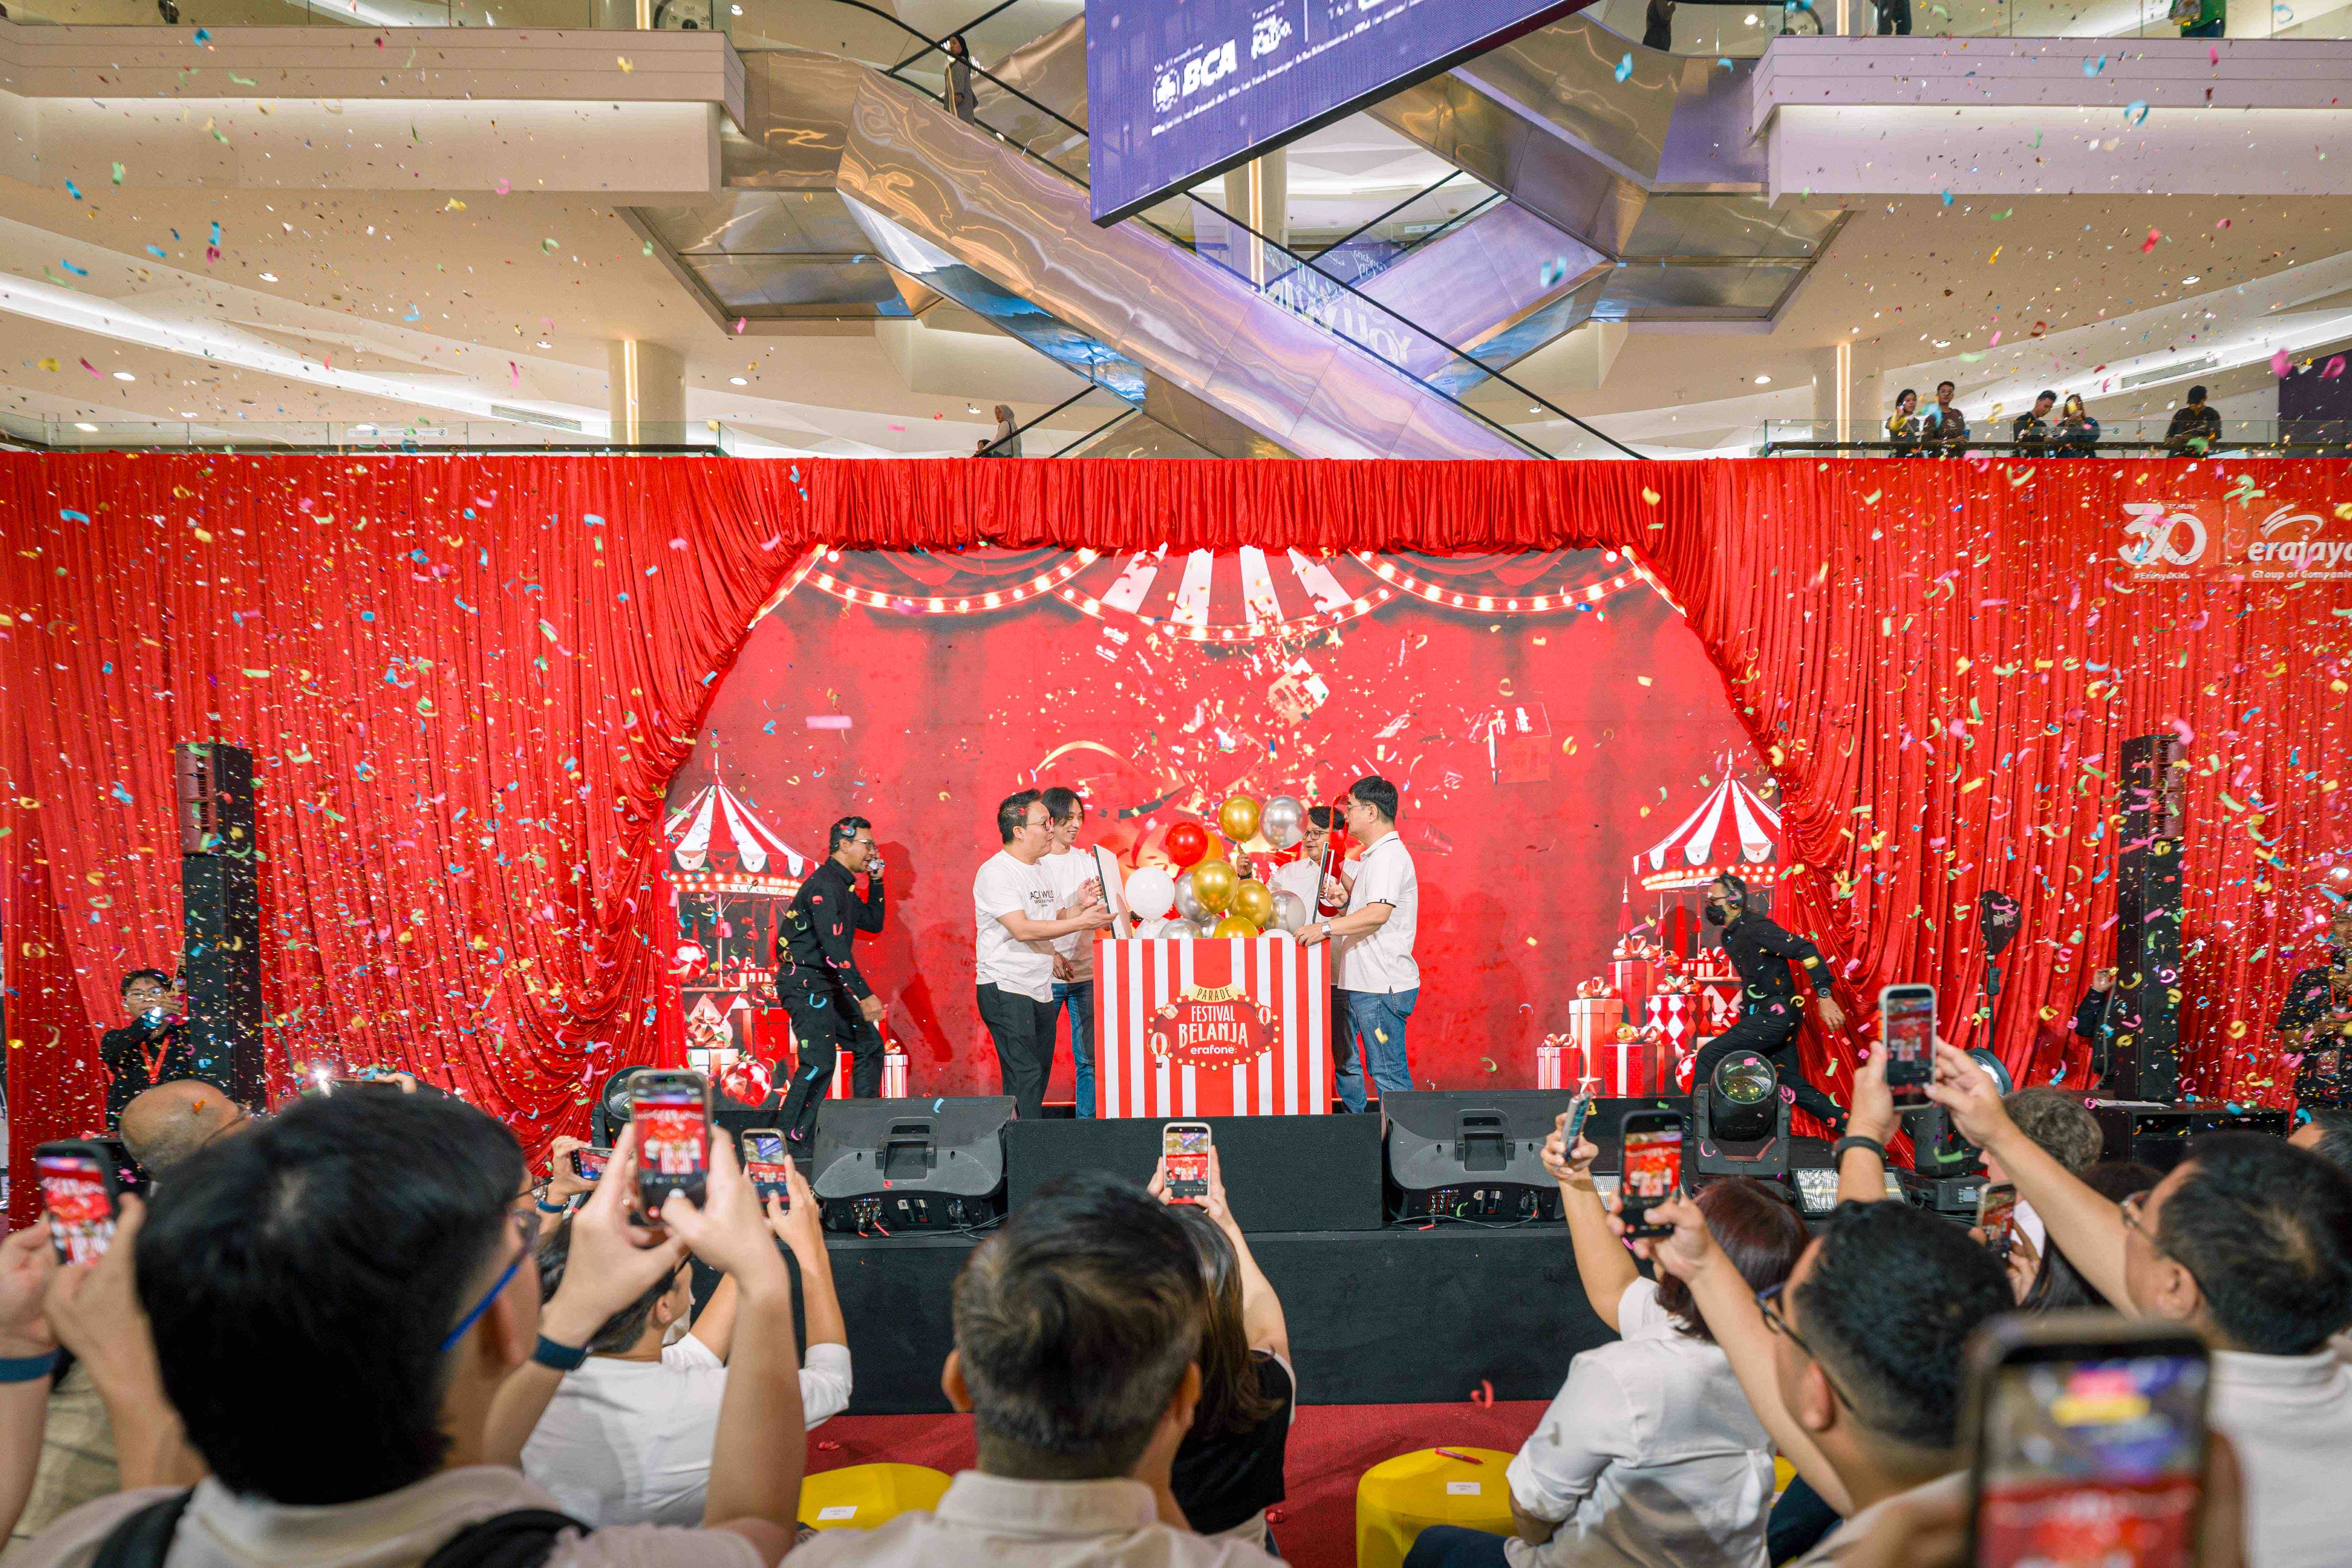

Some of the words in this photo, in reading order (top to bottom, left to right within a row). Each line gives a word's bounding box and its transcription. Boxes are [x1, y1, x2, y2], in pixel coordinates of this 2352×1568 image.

[1182, 39, 1237, 97] BCA
[2118, 503, 2207, 565] 30
[1196, 987, 1232, 1001] PARADE
[1191, 1005, 1235, 1022] FESTIVAL
[1178, 1022, 1249, 1049] BELANJA
[1190, 1044, 1235, 1054] erafone
